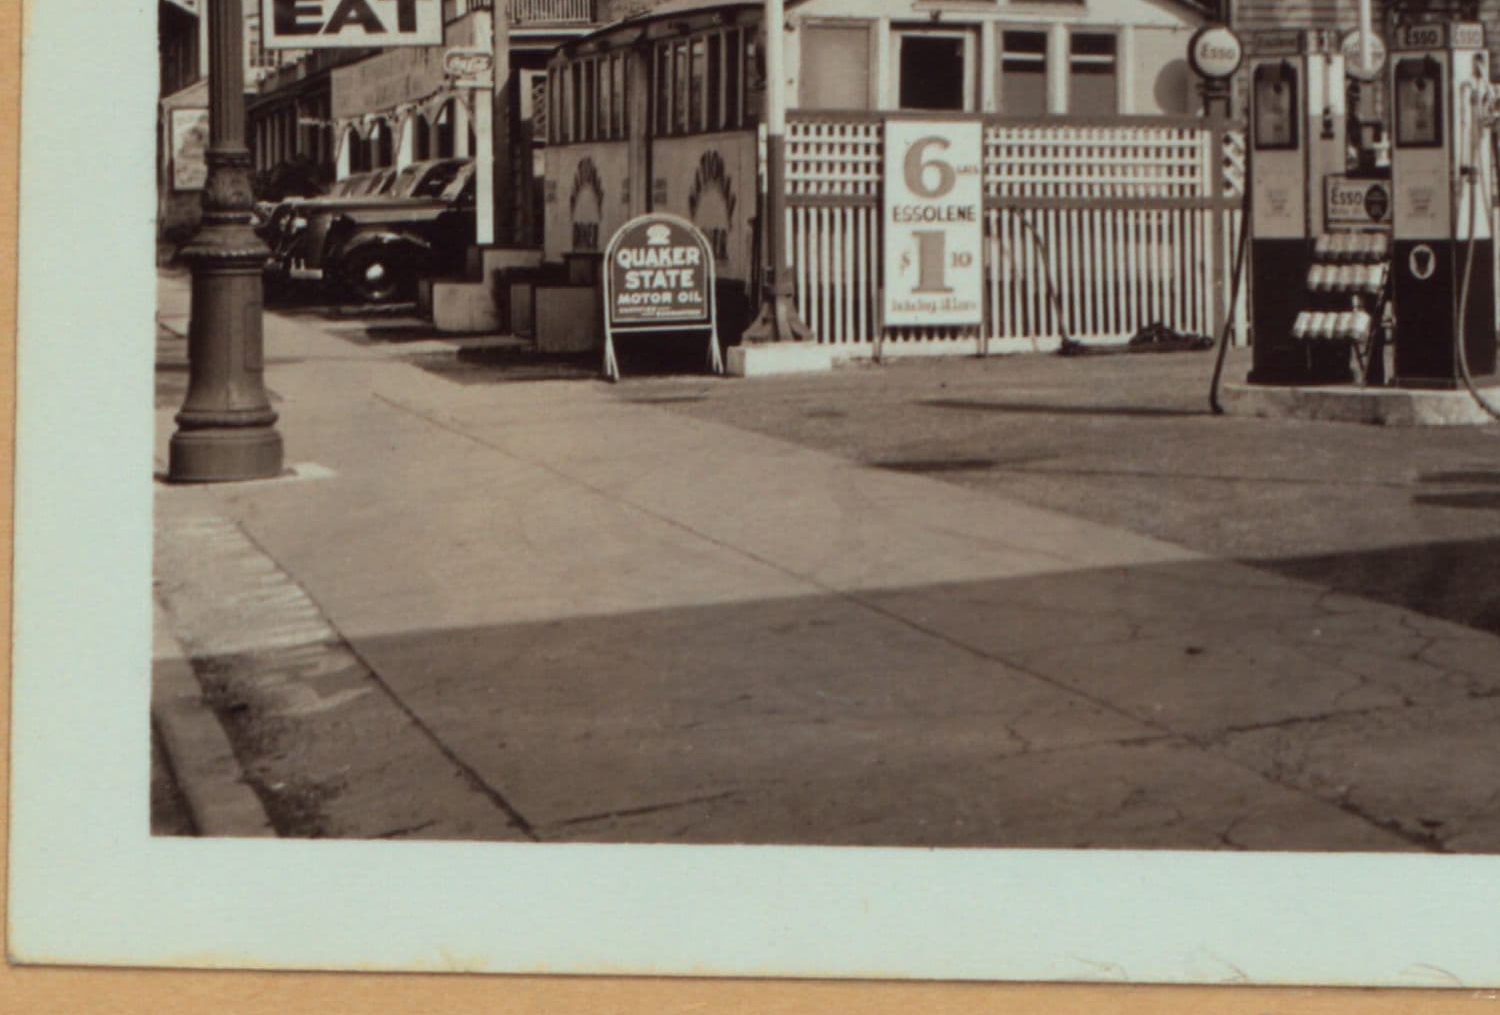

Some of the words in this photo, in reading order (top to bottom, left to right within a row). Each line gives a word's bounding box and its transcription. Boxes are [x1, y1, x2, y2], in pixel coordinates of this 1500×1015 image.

[903, 135, 956, 200] 6
[892, 205, 976, 222] ESSOLENE
[617, 246, 700, 269] QUAKER
[911, 231, 954, 294] 1
[951, 251, 973, 268] 10
[625, 269, 695, 290] STATE
[617, 291, 673, 305] MOTOR
[677, 290, 702, 303] OIL
